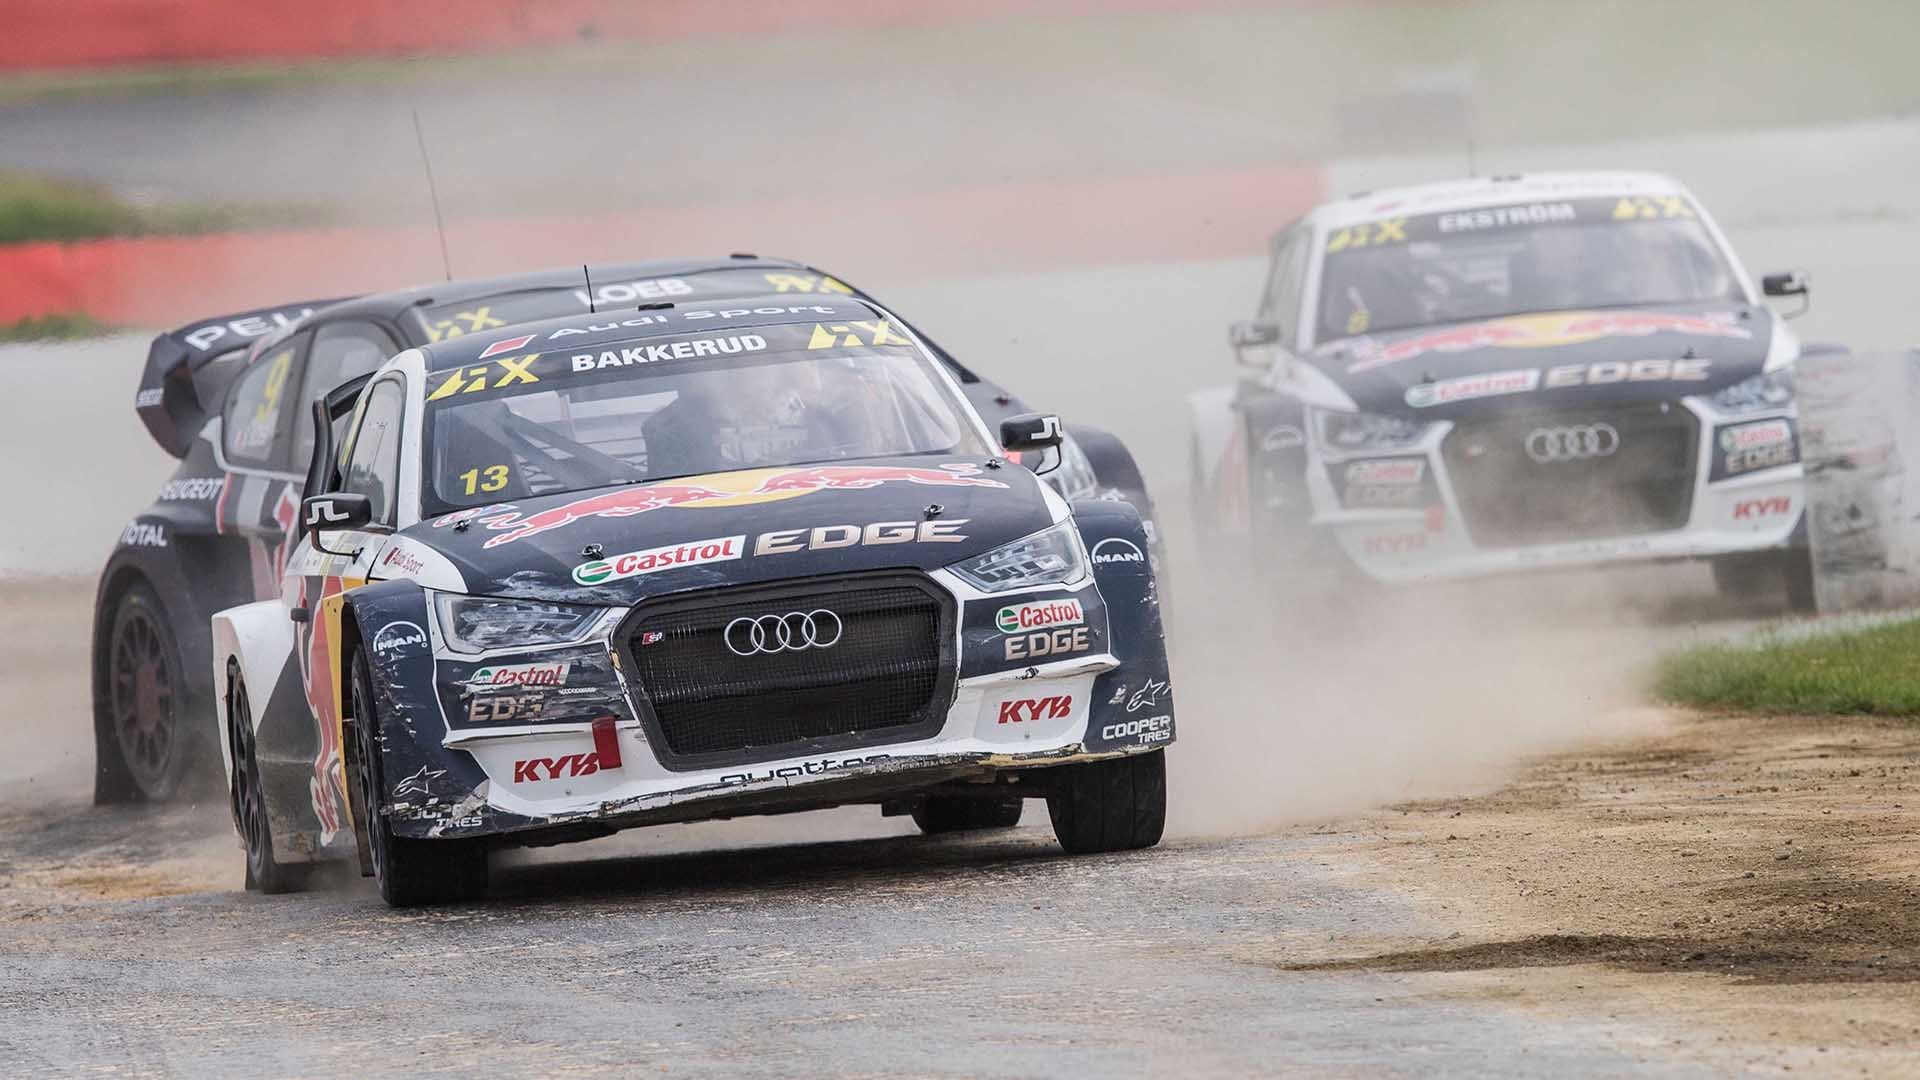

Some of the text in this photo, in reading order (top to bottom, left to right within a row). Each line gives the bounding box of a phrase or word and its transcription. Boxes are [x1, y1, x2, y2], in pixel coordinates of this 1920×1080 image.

[1438, 202, 1577, 233] EKSTRÖM
[574, 278, 694, 308] LOEB
[549, 304, 836, 341] Audi Sport
[571, 333, 768, 373] BAKKERUD
[255, 352, 290, 423] 9
[1437, 358, 1713, 402] Castrol EDGE
[1726, 444, 1796, 472] EDGE
[459, 464, 509, 497] 13
[1732, 495, 1791, 521] KYB
[122, 522, 168, 548] TOTAL
[753, 518, 972, 557] EDGE
[615, 538, 738, 577] Castrol
[1095, 551, 1143, 563] MAN
[1019, 600, 1082, 630] Castrol
[378, 634, 422, 651] MAN
[1005, 626, 1089, 661] EDGE
[491, 664, 564, 686] Castrol
[997, 695, 1072, 725] KYB
[1102, 715, 1171, 741] COOPER
[1137, 729, 1170, 744] TIRES
[513, 751, 601, 784] KYB
